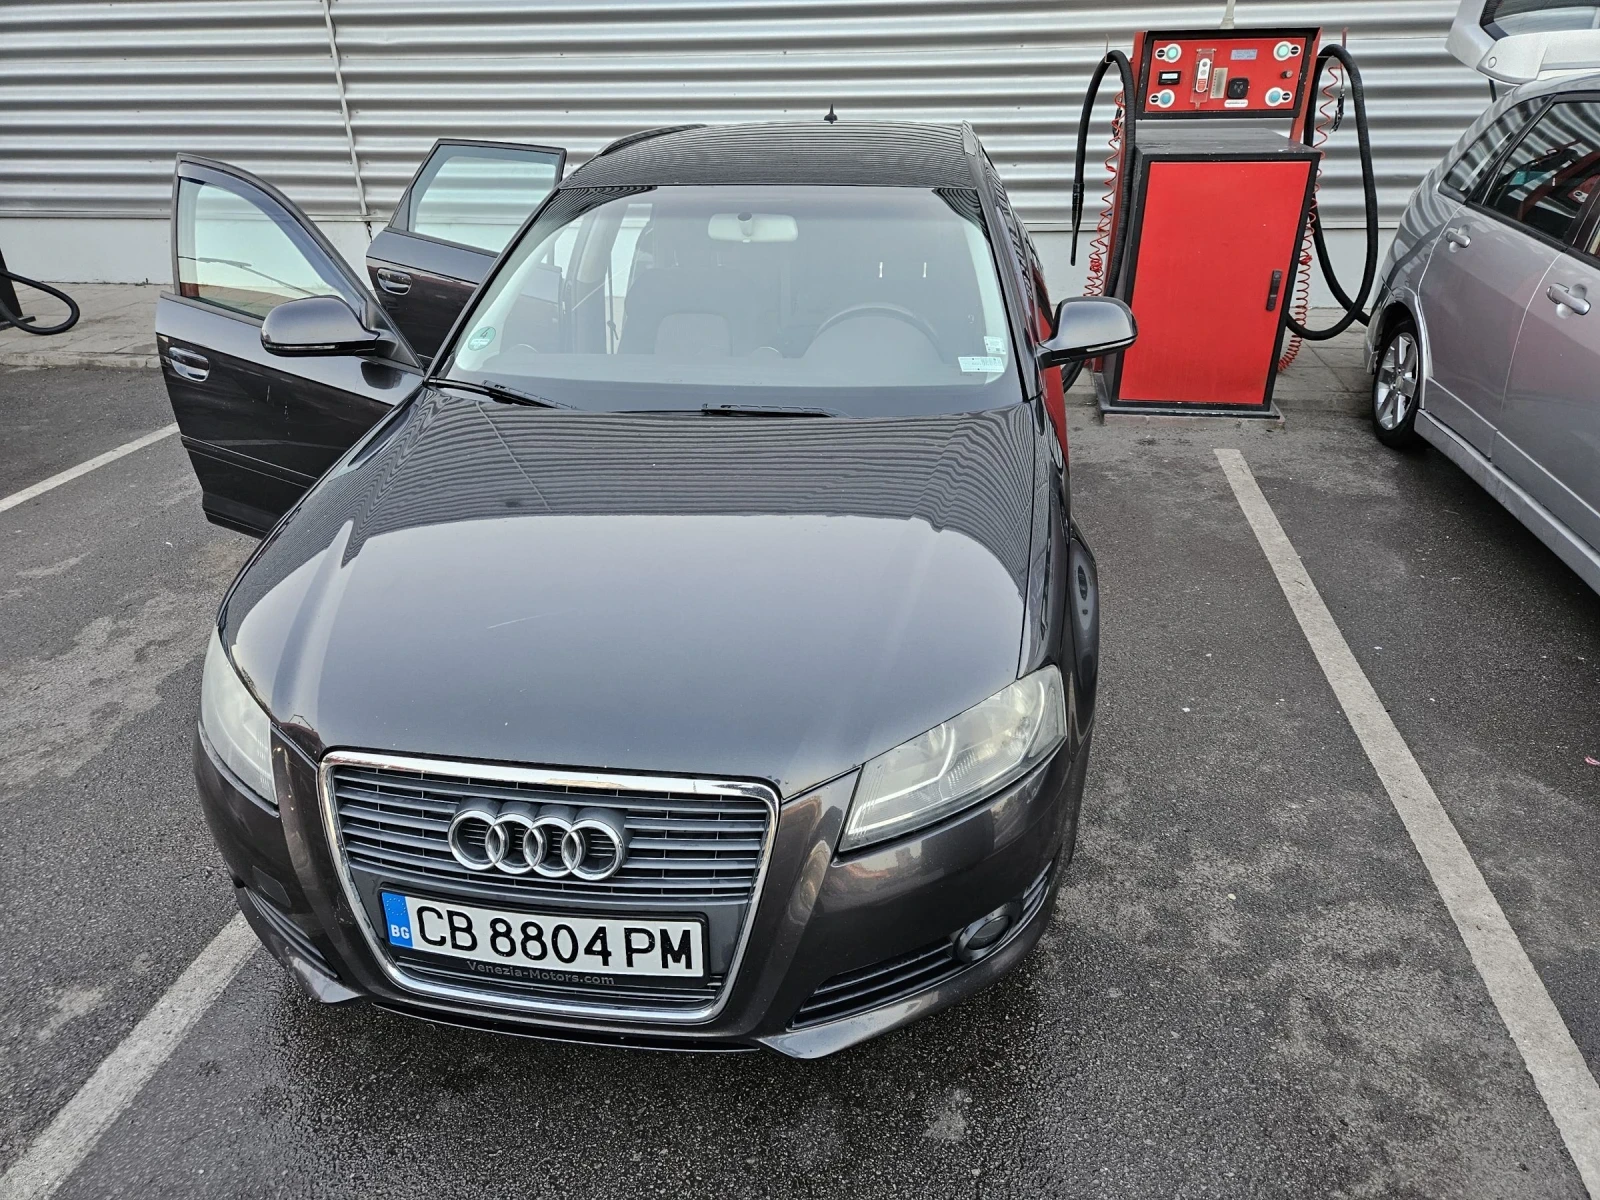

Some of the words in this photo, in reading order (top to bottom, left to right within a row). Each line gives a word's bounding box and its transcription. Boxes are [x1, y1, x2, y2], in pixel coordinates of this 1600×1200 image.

[390, 924, 411, 939] BG
[416, 905, 478, 951] CB
[489, 917, 612, 966] 8804
[623, 927, 693, 970] PM
[467, 961, 615, 985] Venezia-Motors.com
